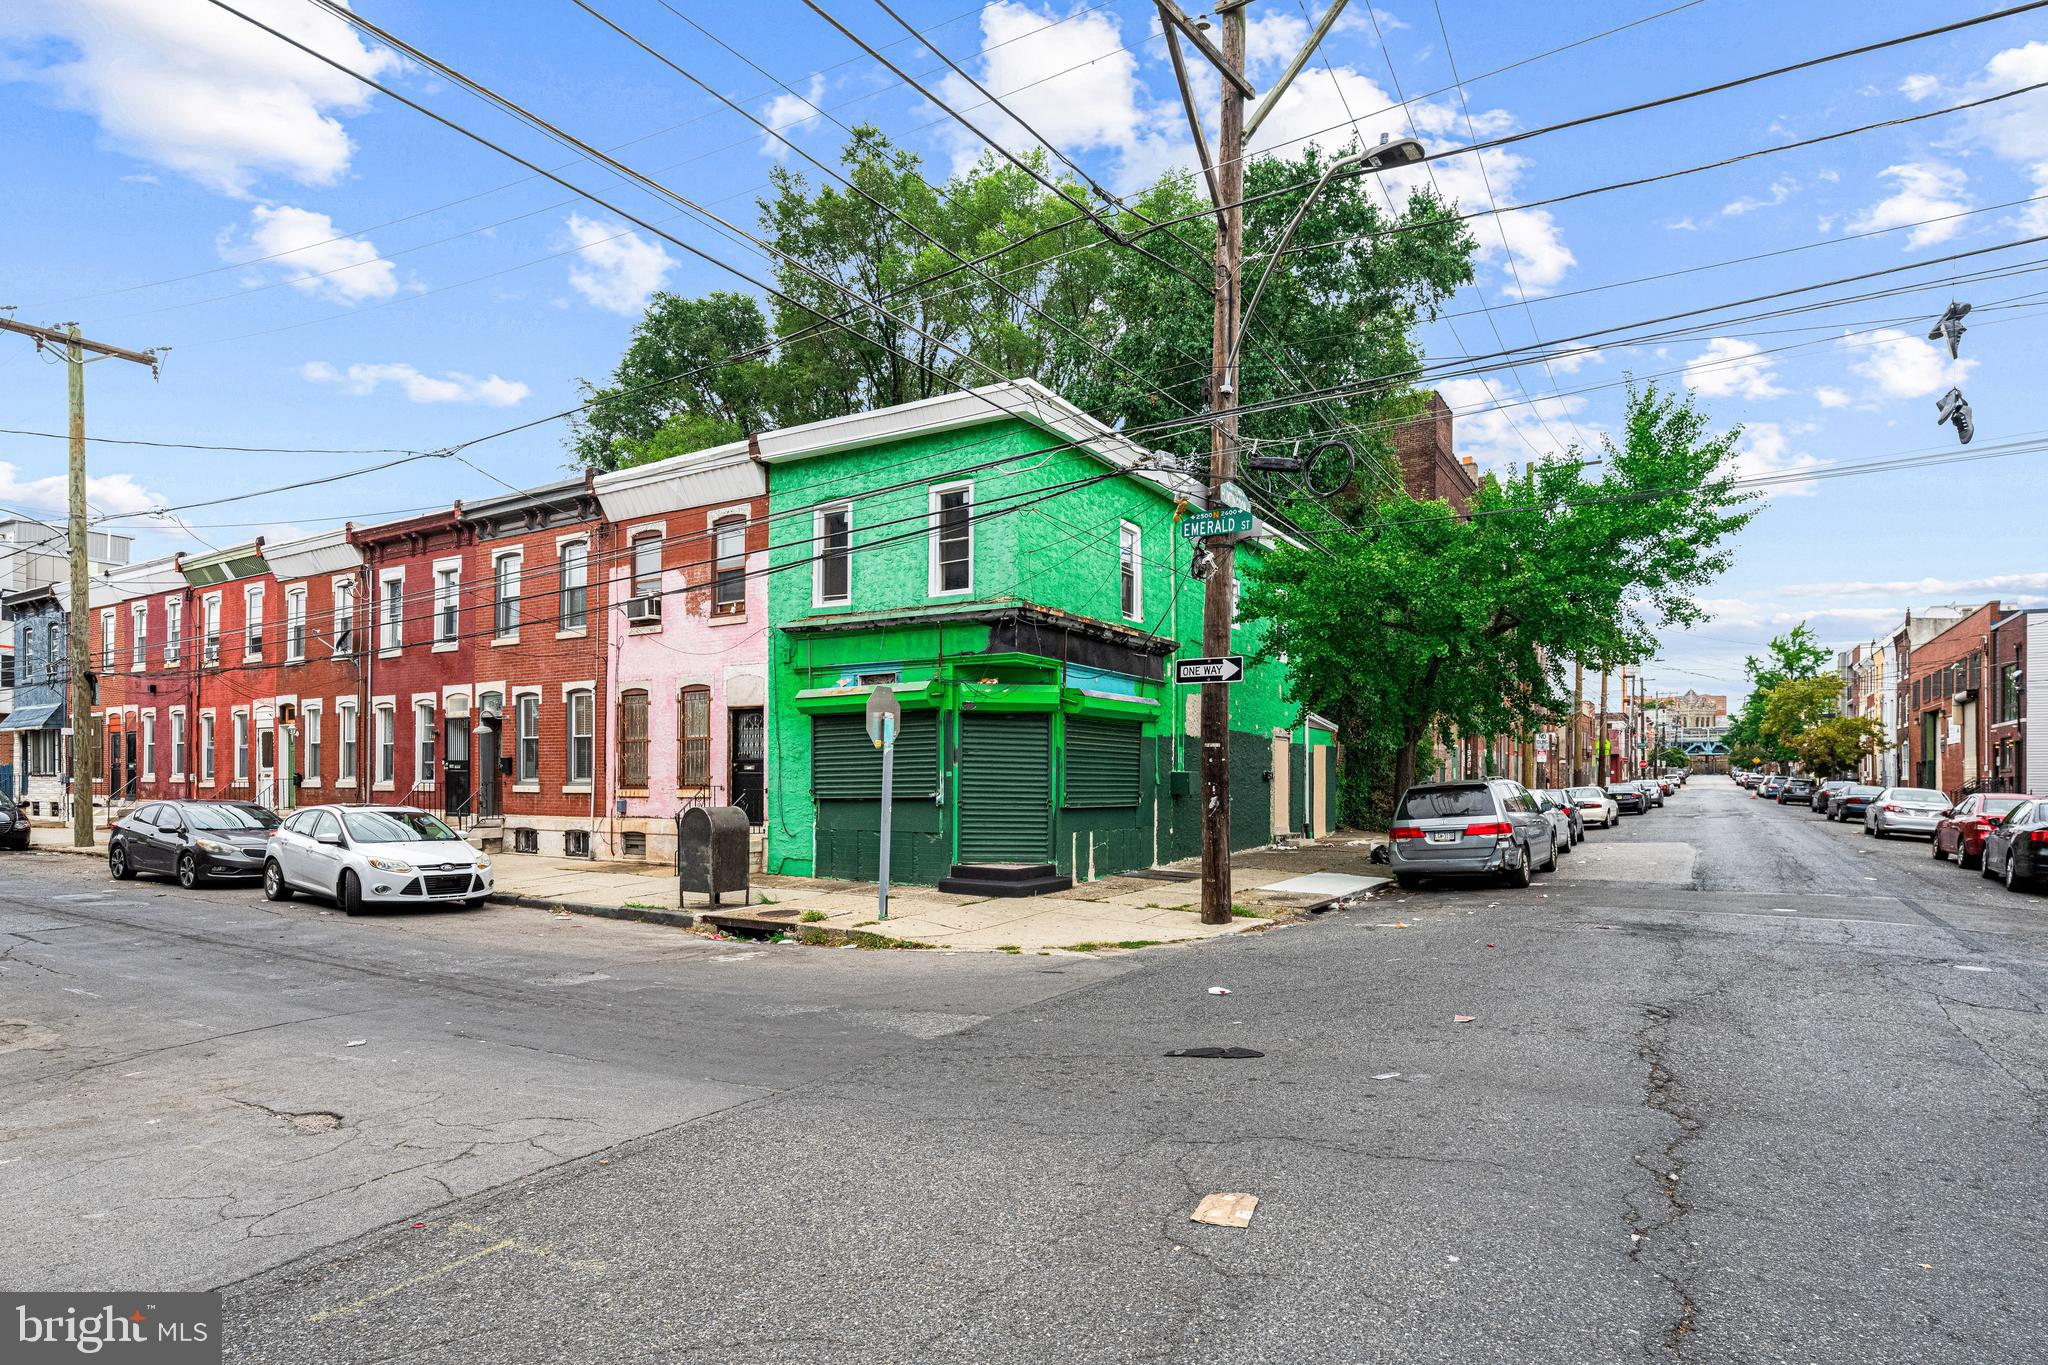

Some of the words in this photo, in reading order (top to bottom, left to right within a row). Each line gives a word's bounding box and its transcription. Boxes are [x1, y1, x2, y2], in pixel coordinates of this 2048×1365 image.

[1184, 518, 1235, 536] EMERALD
[1241, 520, 1250, 530] ST
[1182, 667, 1200, 676] ONE
[1204, 666, 1222, 675] WAY
